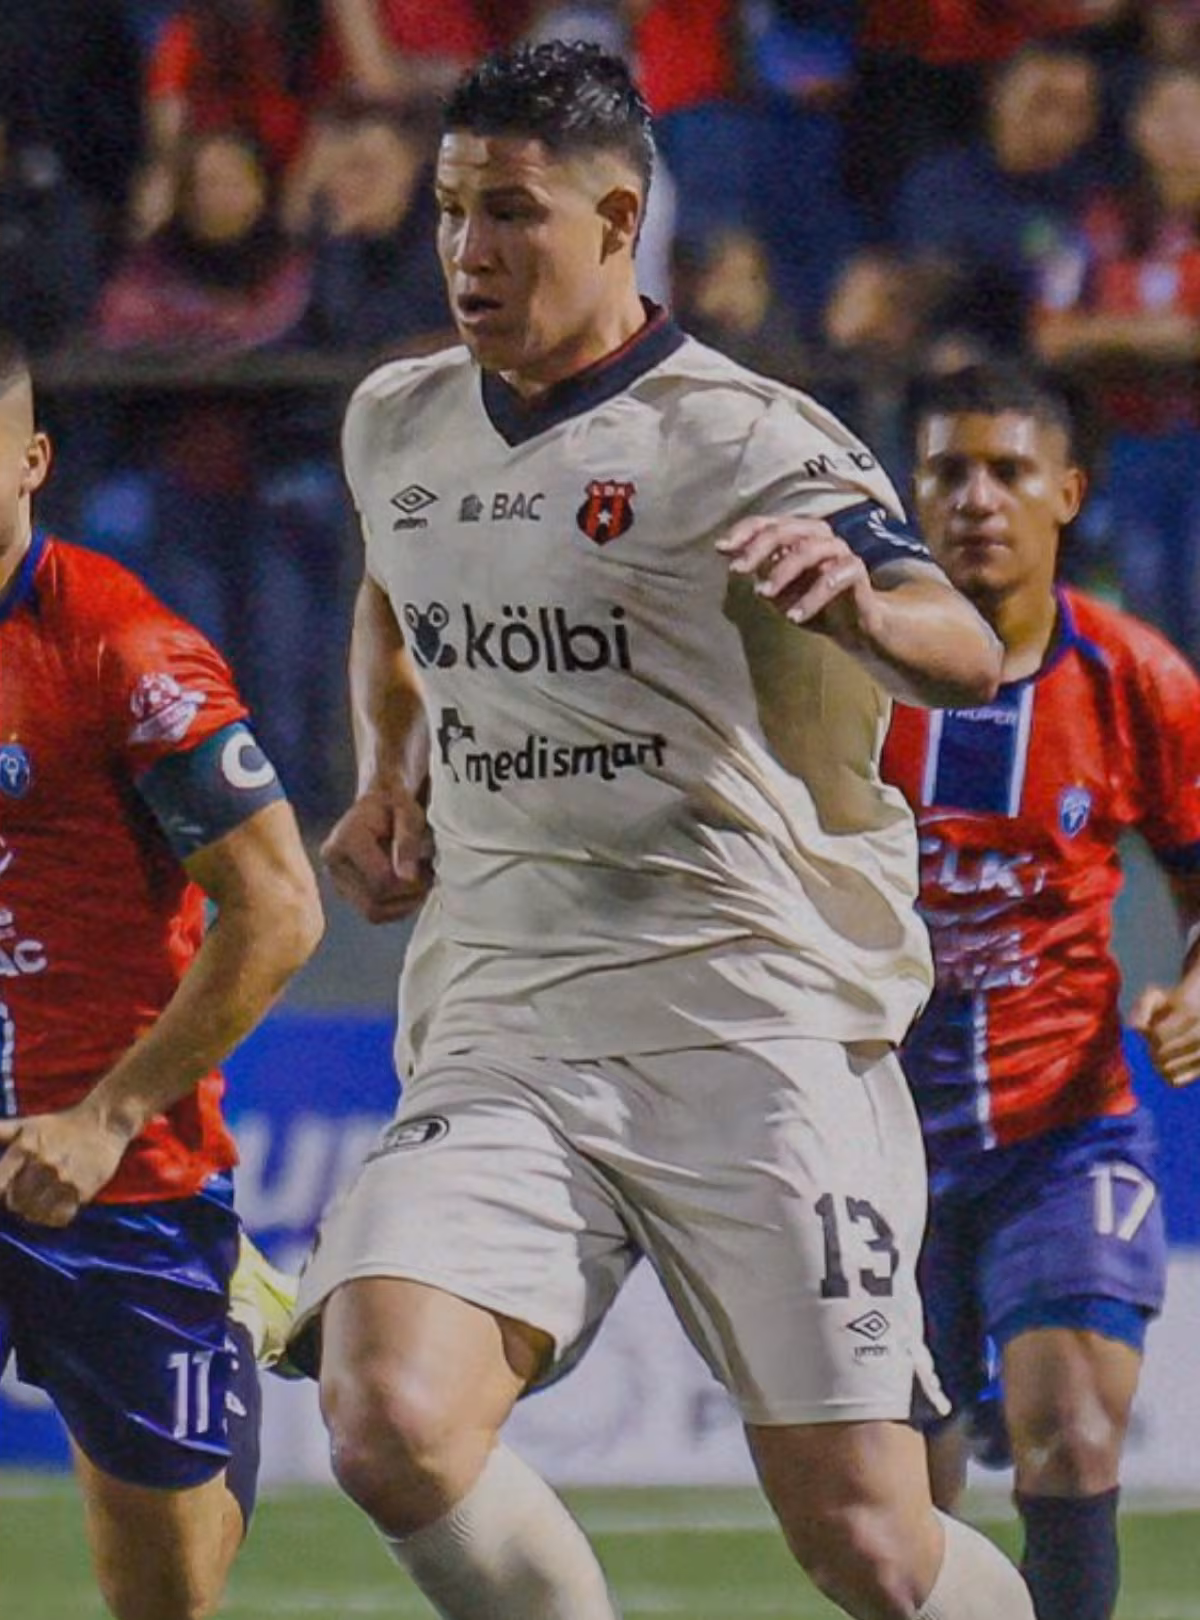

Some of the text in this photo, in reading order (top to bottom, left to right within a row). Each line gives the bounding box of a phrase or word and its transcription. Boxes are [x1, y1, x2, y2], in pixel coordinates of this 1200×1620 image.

[491, 493, 546, 520] BAC
[462, 603, 631, 673] kölbi
[221, 733, 276, 788] C
[466, 734, 667, 792] medismart
[1088, 1162, 1156, 1241] 17
[814, 1192, 899, 1299] 13
[167, 1352, 214, 1439] 11
